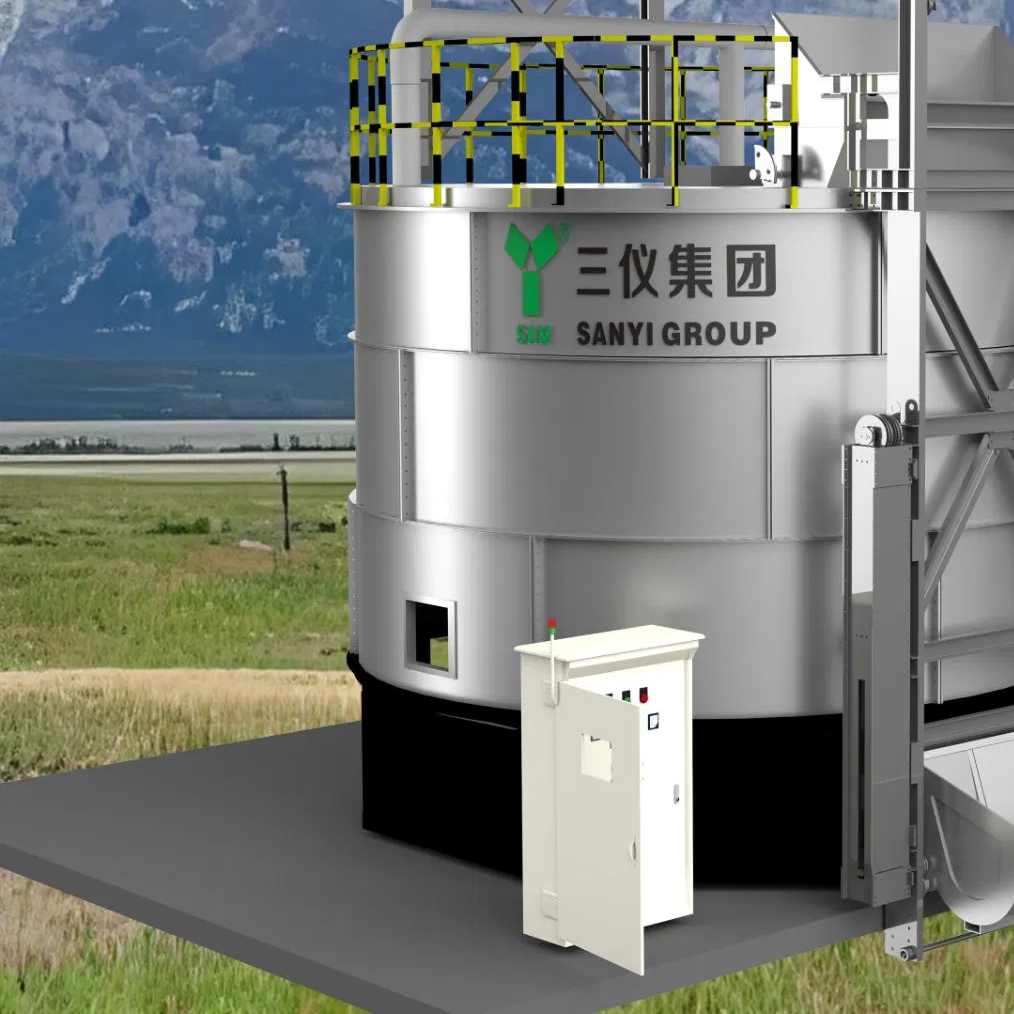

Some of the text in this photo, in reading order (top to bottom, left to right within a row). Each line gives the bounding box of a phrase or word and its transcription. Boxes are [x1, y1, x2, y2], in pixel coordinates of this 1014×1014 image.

[577, 243, 777, 298] 三仪集团
[577, 321, 777, 346] SANYI GROUP
